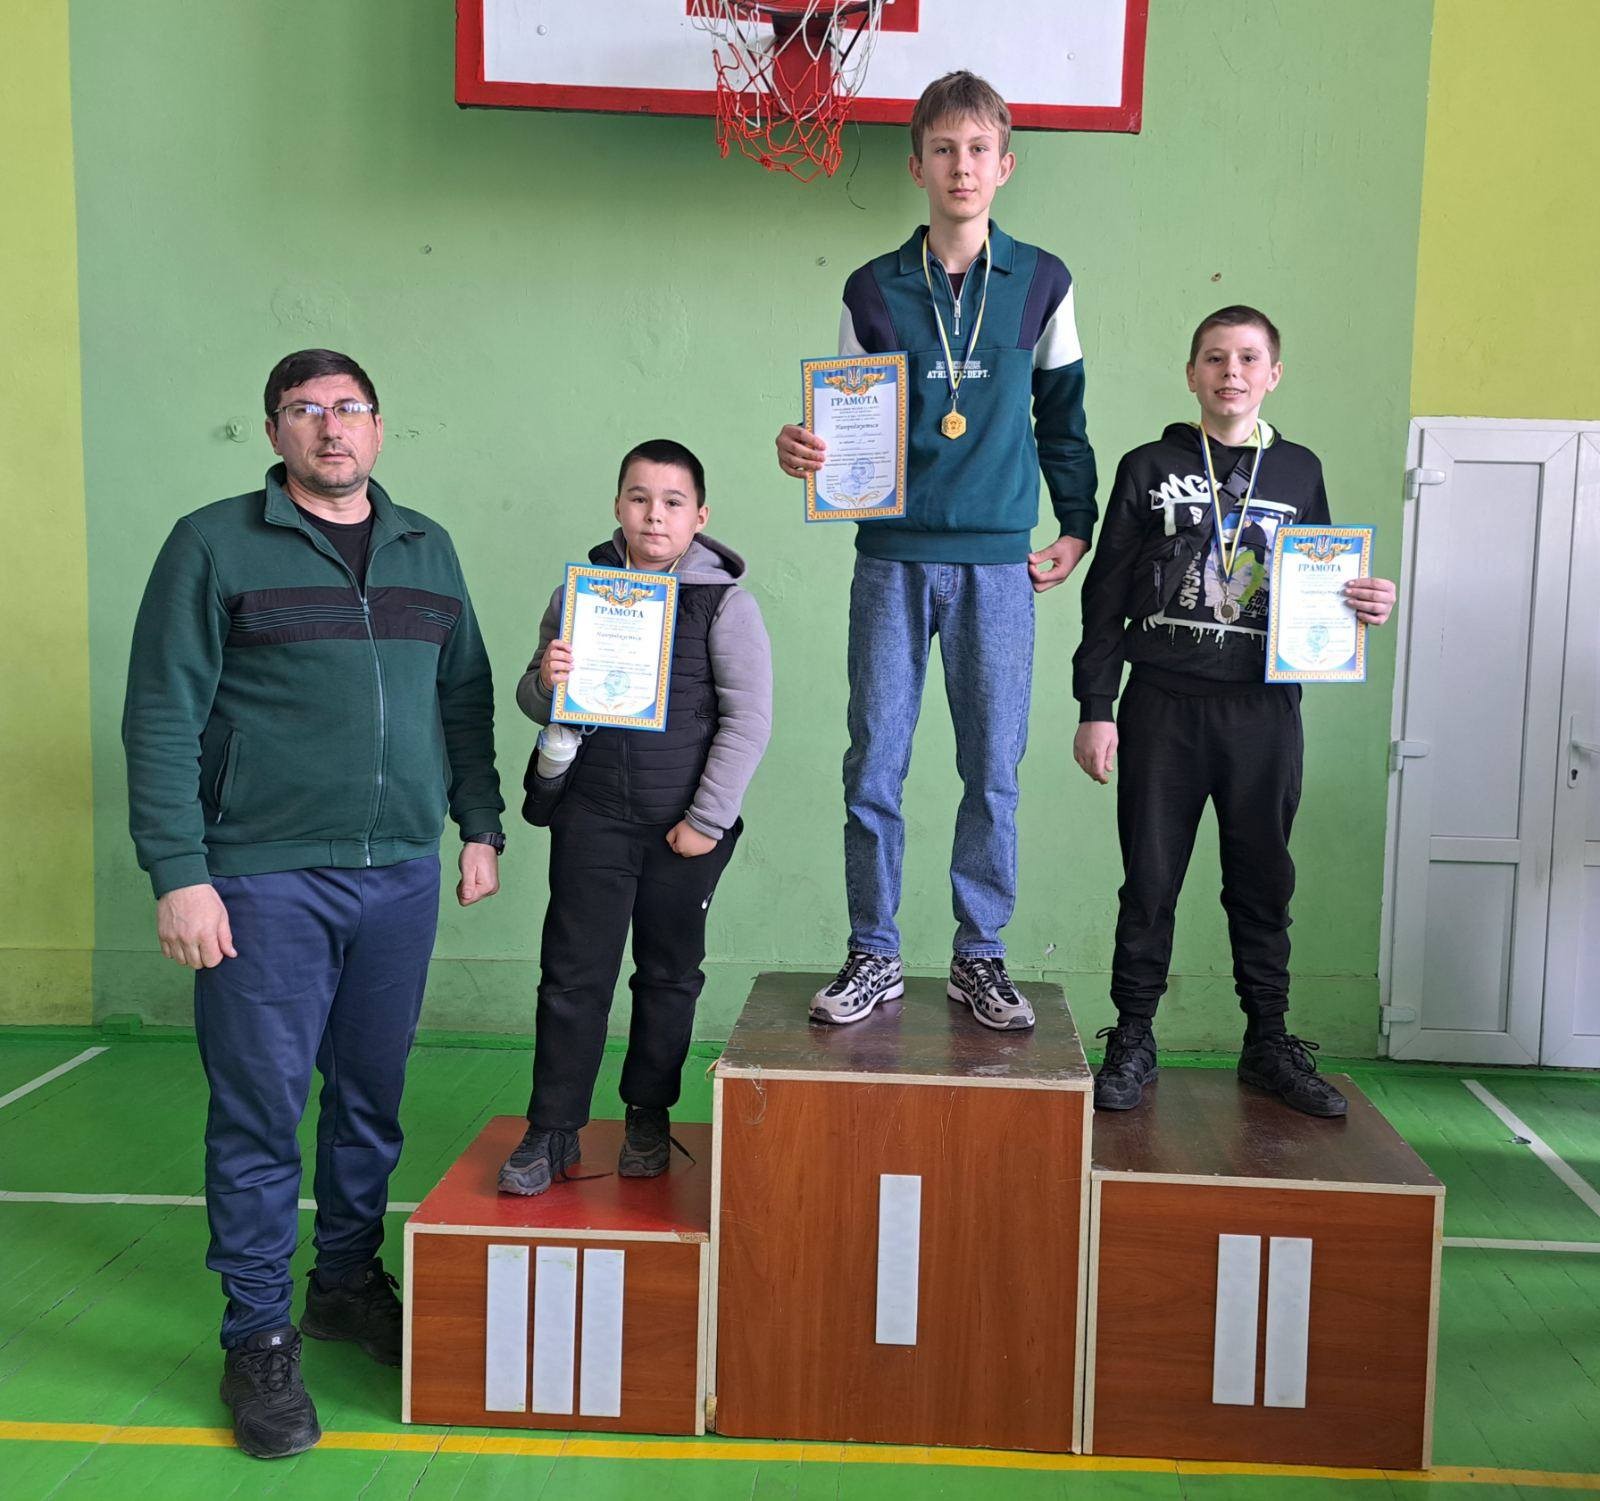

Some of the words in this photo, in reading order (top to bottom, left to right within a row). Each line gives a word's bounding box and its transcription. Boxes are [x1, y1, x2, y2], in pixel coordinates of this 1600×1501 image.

[967, 369, 991, 379] DEPT.
[830, 395, 879, 406] ГРАМОТА
[1298, 563, 1341, 572] ГРАМОТА
[594, 605, 644, 618] ГРАМОТА
